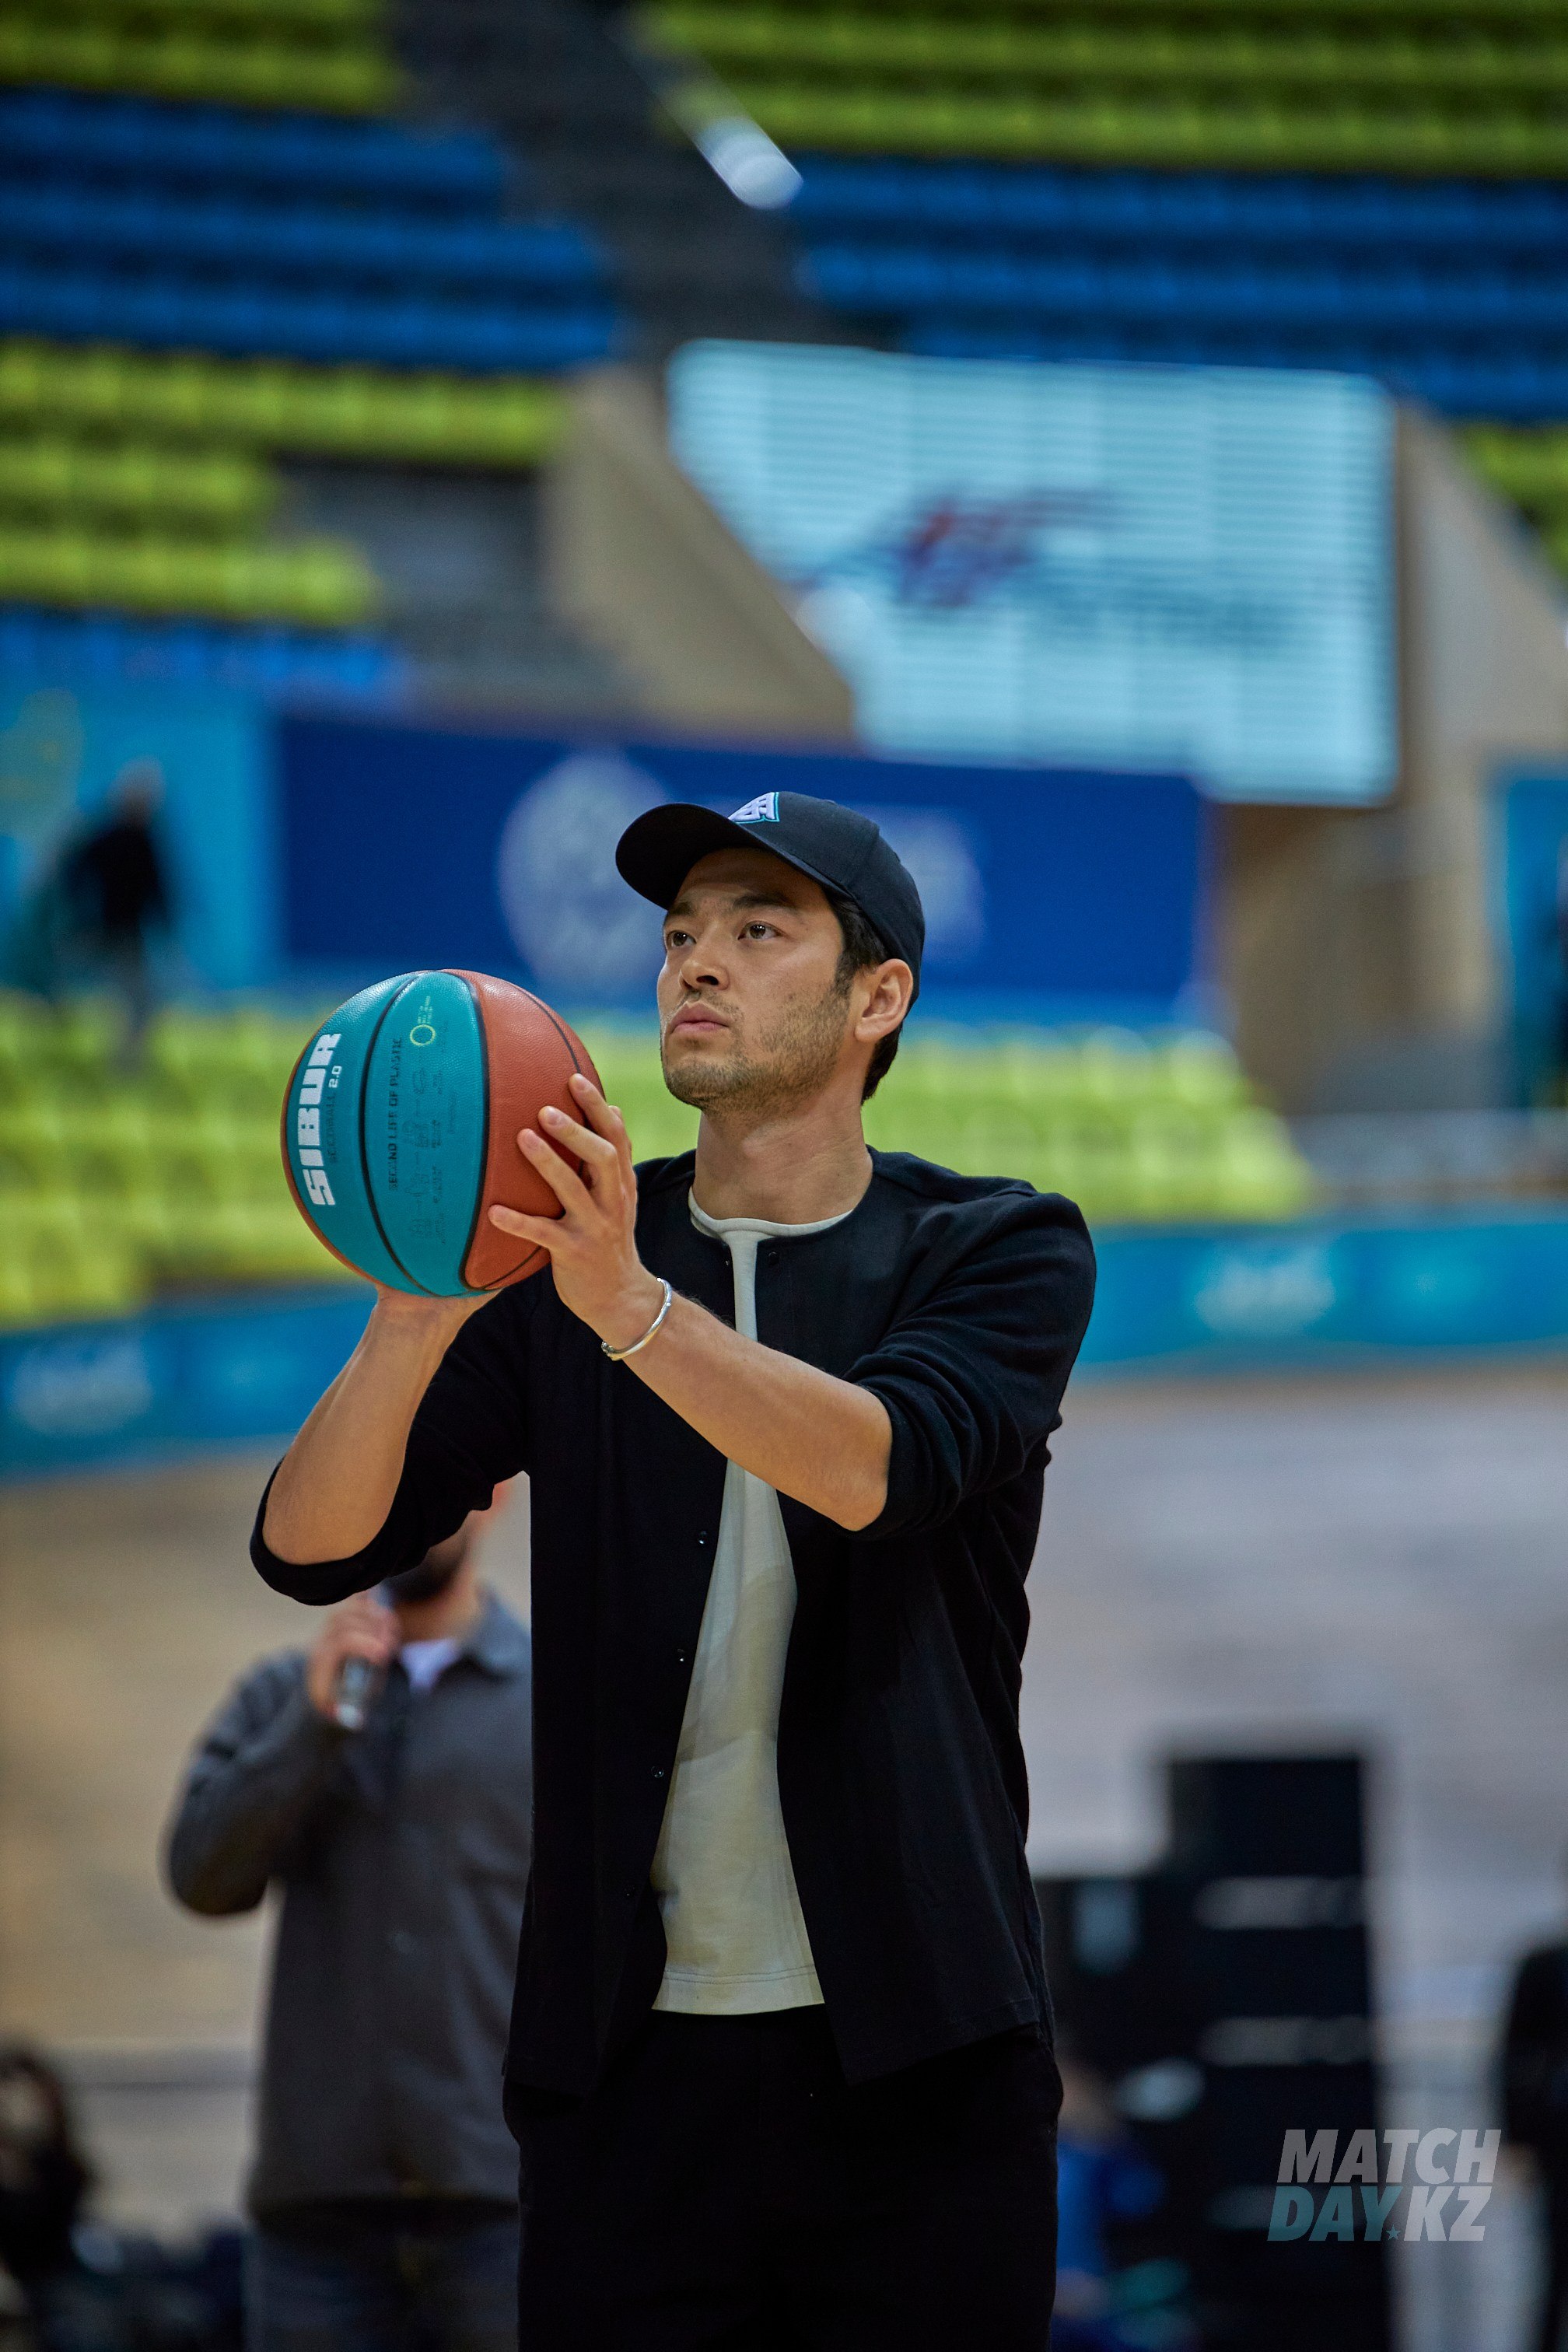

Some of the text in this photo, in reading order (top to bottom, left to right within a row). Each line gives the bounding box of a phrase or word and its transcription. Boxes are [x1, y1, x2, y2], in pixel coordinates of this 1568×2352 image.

[298, 1033, 341, 1206] SIBUR
[328, 1065, 342, 1088] 2.0
[387, 1037, 402, 1191] SECOND LIFE OF PLASTIC
